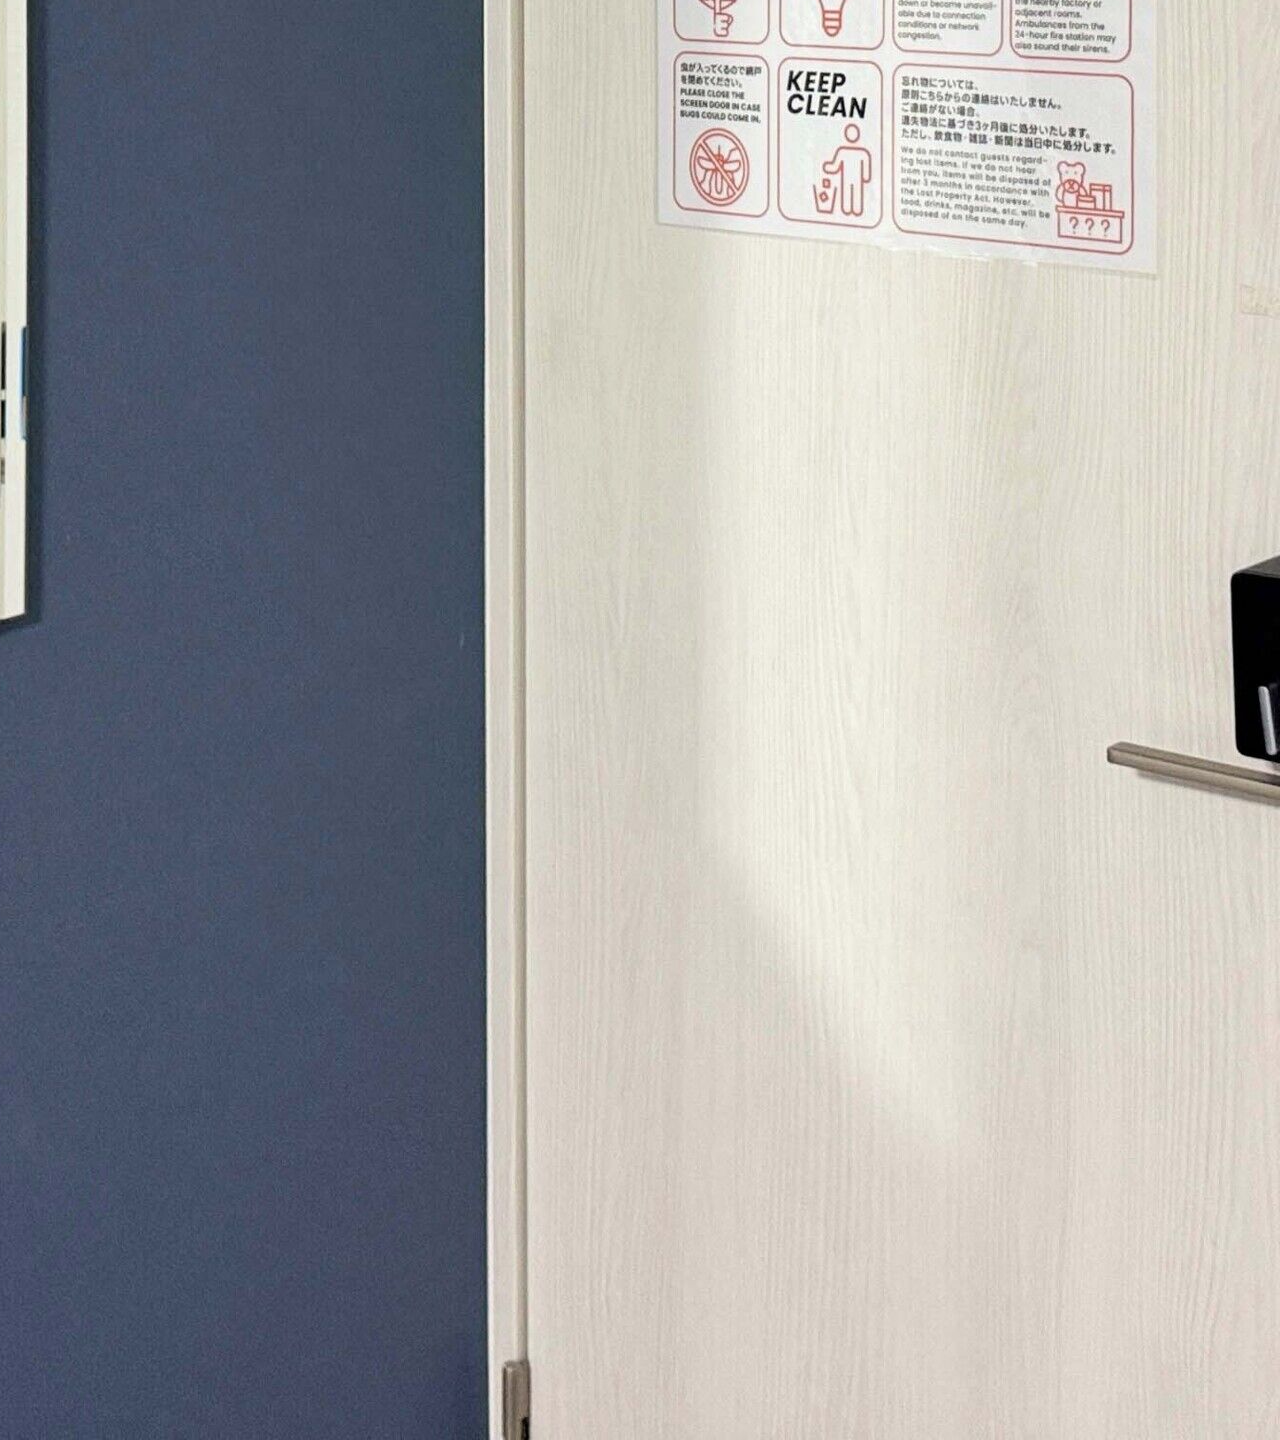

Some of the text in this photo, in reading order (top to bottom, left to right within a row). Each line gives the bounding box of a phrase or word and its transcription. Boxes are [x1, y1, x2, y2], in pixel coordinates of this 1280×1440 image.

[930, 0, 962, 8] become
[1062, 0, 1091, 9] factory
[917, 10, 931, 18] due
[933, 10, 940, 18] to
[942, 11, 986, 20] connection
[1015, 8, 1054, 18] adjacent
[898, 21, 937, 29] conditions
[948, 22, 979, 31] network
[1015, 20, 1105, 30] Ambulances from the
[1015, 30, 1116, 44] 24-hour fire station may
[1034, 43, 1059, 51] sound
[1061, 43, 1080, 52] their
[1083, 44, 1110, 53] sirens.
[681, 63, 762, 76] 虫が入ってくるので網戸
[787, 70, 846, 93] KEEP
[902, 76, 978, 90] 忘れ物については、
[681, 88, 745, 99] PLEASE CLOSE THE
[901, 89, 1061, 110] 原則こちらからの連絡はいたしません。
[681, 99, 708, 108] SCREEN
[709, 101, 730, 109] DOOR
[741, 103, 761, 112] CASE
[787, 94, 867, 119] CLEAN
[901, 102, 980, 117] ご連絡がない場合、
[680, 110, 761, 123] BUGS COULD COME IN.
[901, 146, 913, 154] We
[916, 147, 926, 155] do
[945, 150, 978, 159] contact
[981, 153, 1009, 162] guests
[1012, 156, 1048, 165] regard-
[901, 157, 914, 166] ing
[916, 157, 931, 165] lost
[1016, 166, 1036, 174] hear
[901, 166, 920, 175] from
[942, 170, 966, 180] items
[999, 175, 1040, 185] disposed
[1042, 178, 1051, 186] of
[901, 187, 914, 195] the
[917, 189, 933, 197] Lost
[935, 190, 972, 202] Property
[930, 180, 962, 189] months
[965, 182, 973, 190] in
[975, 185, 1027, 194] accordance
[1031, 188, 1050, 197] with
[901, 208, 939, 218] disposed
[965, 214, 979, 222] the
[981, 216, 1006, 225] same
[1008, 218, 1028, 229] day.
[1021, 209, 1036, 217] will
